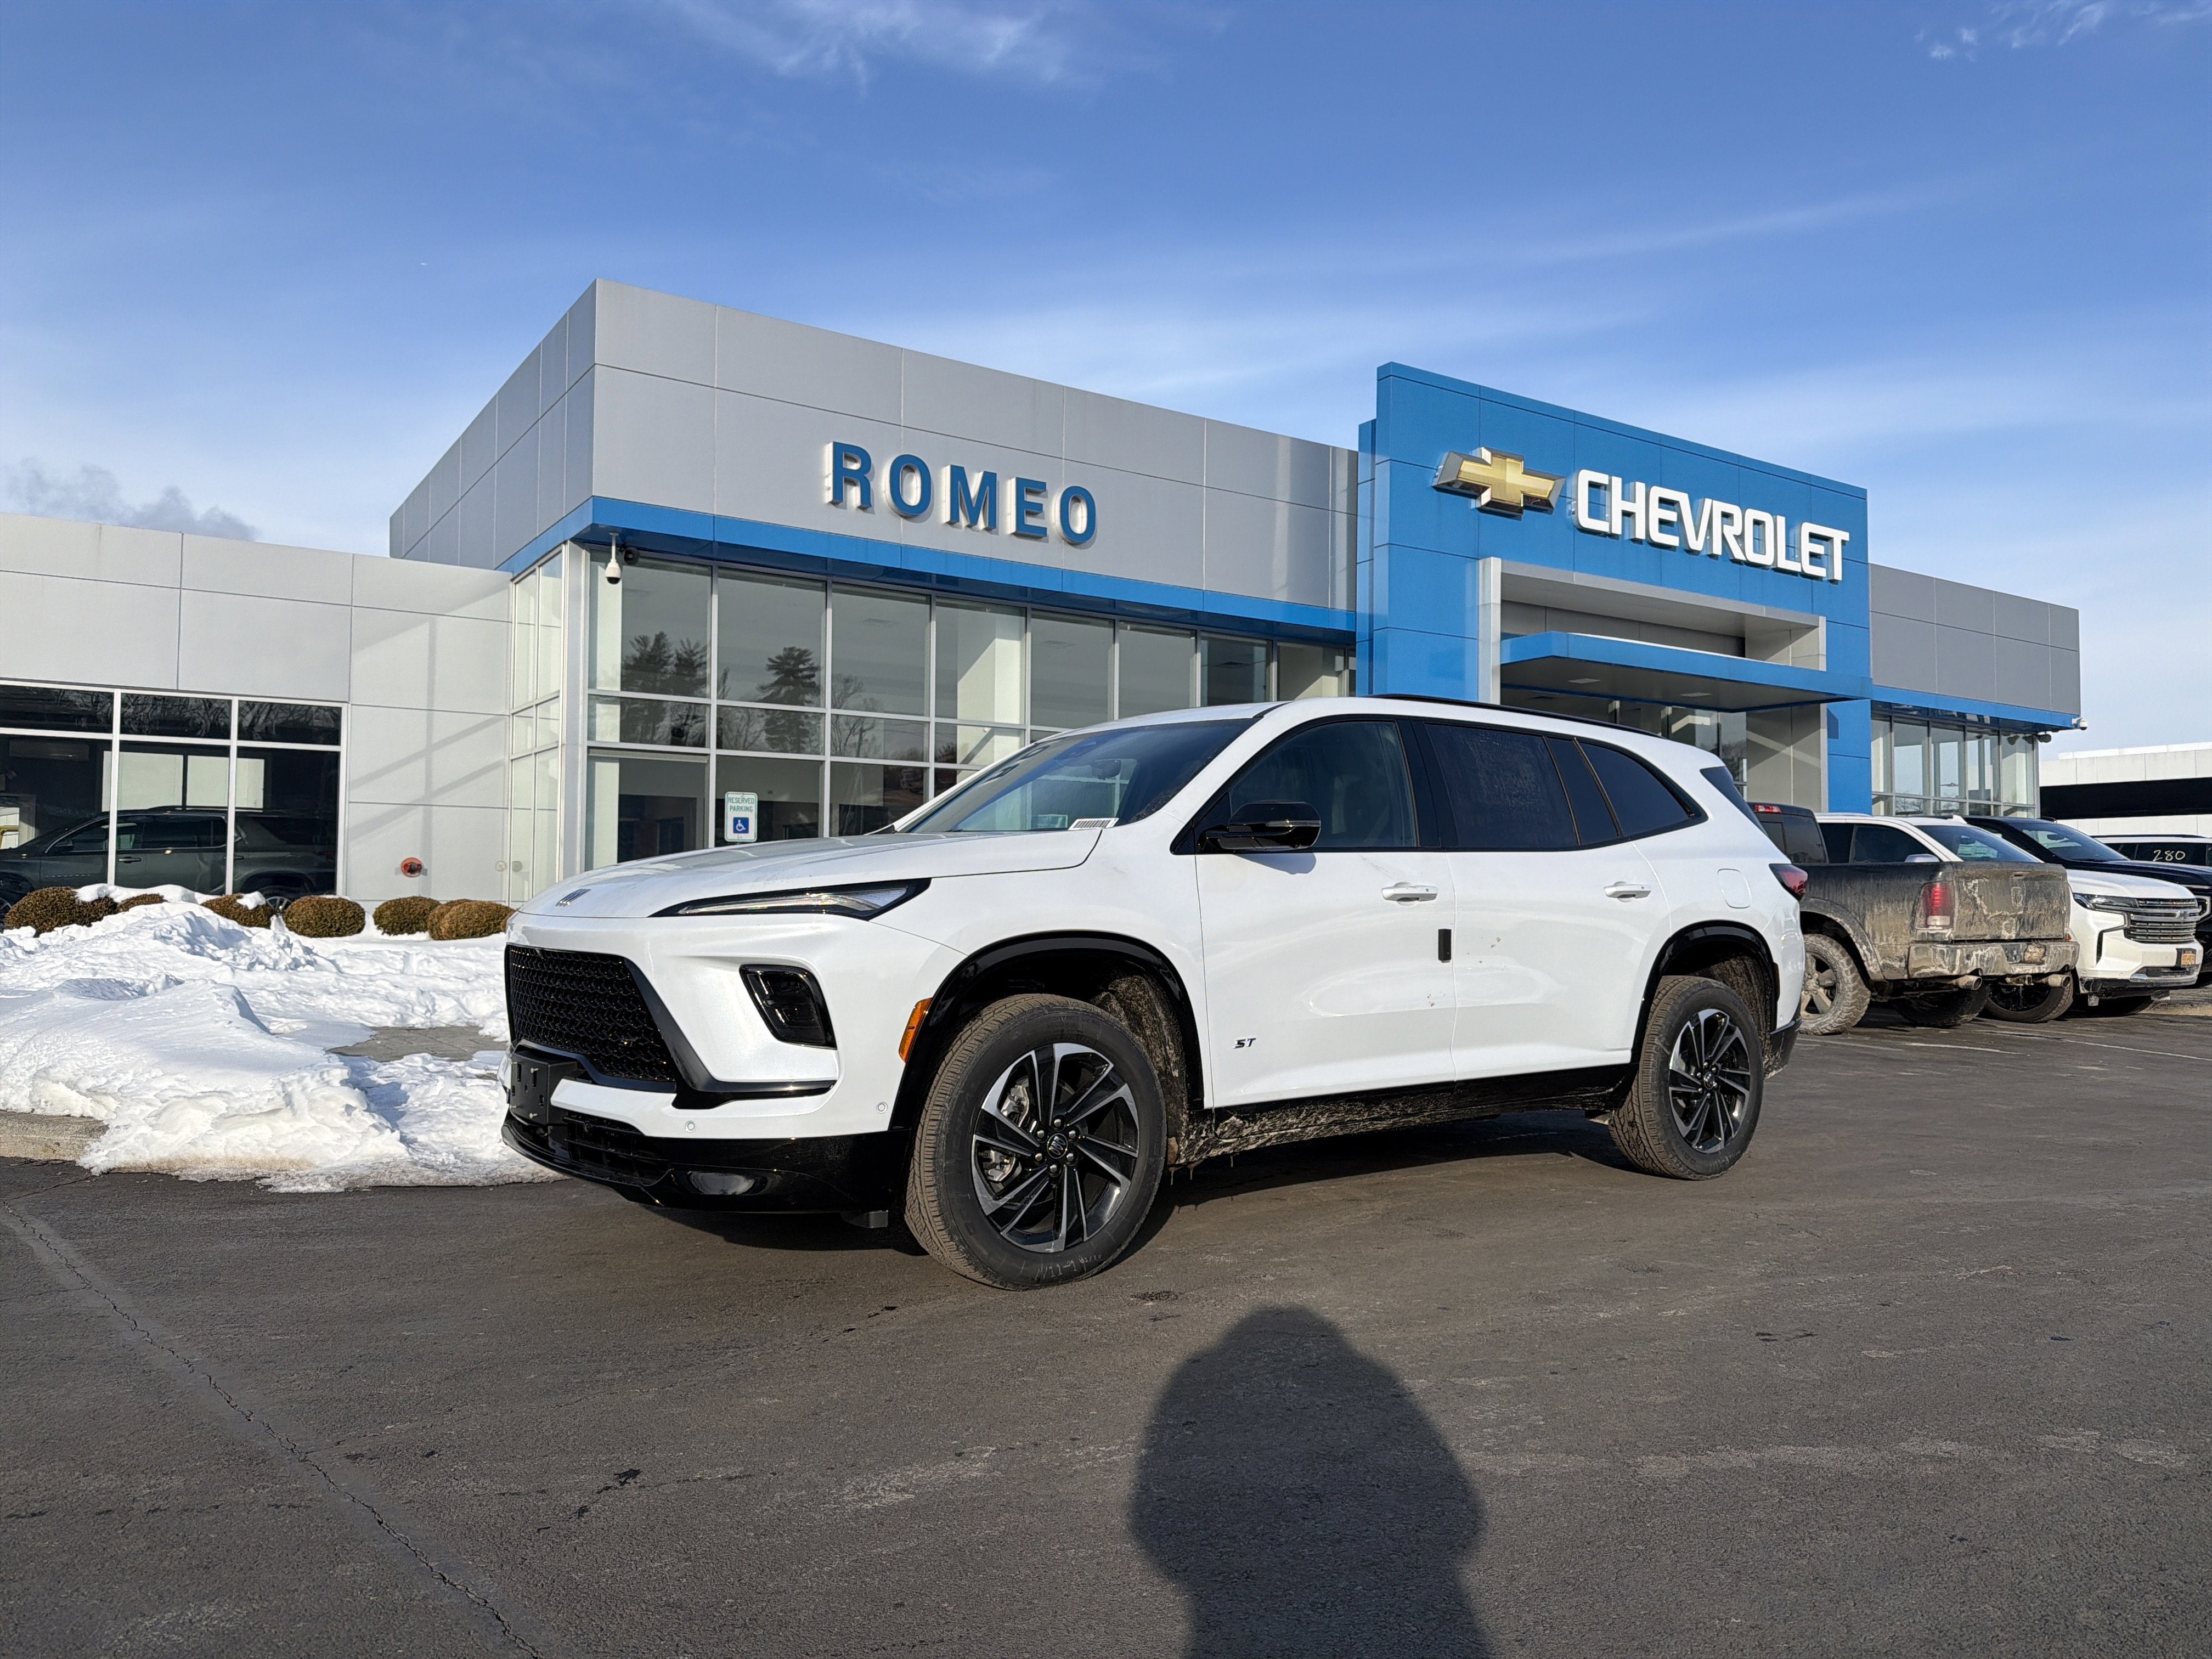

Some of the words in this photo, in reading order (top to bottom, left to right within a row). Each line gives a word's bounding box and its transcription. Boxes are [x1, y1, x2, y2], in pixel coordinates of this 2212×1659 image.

[830, 441, 1097, 544] ROMEO
[1576, 469, 1850, 582] CHEVROLET
[2152, 849, 2186, 862] 280
[1233, 1037, 1256, 1049] ST
